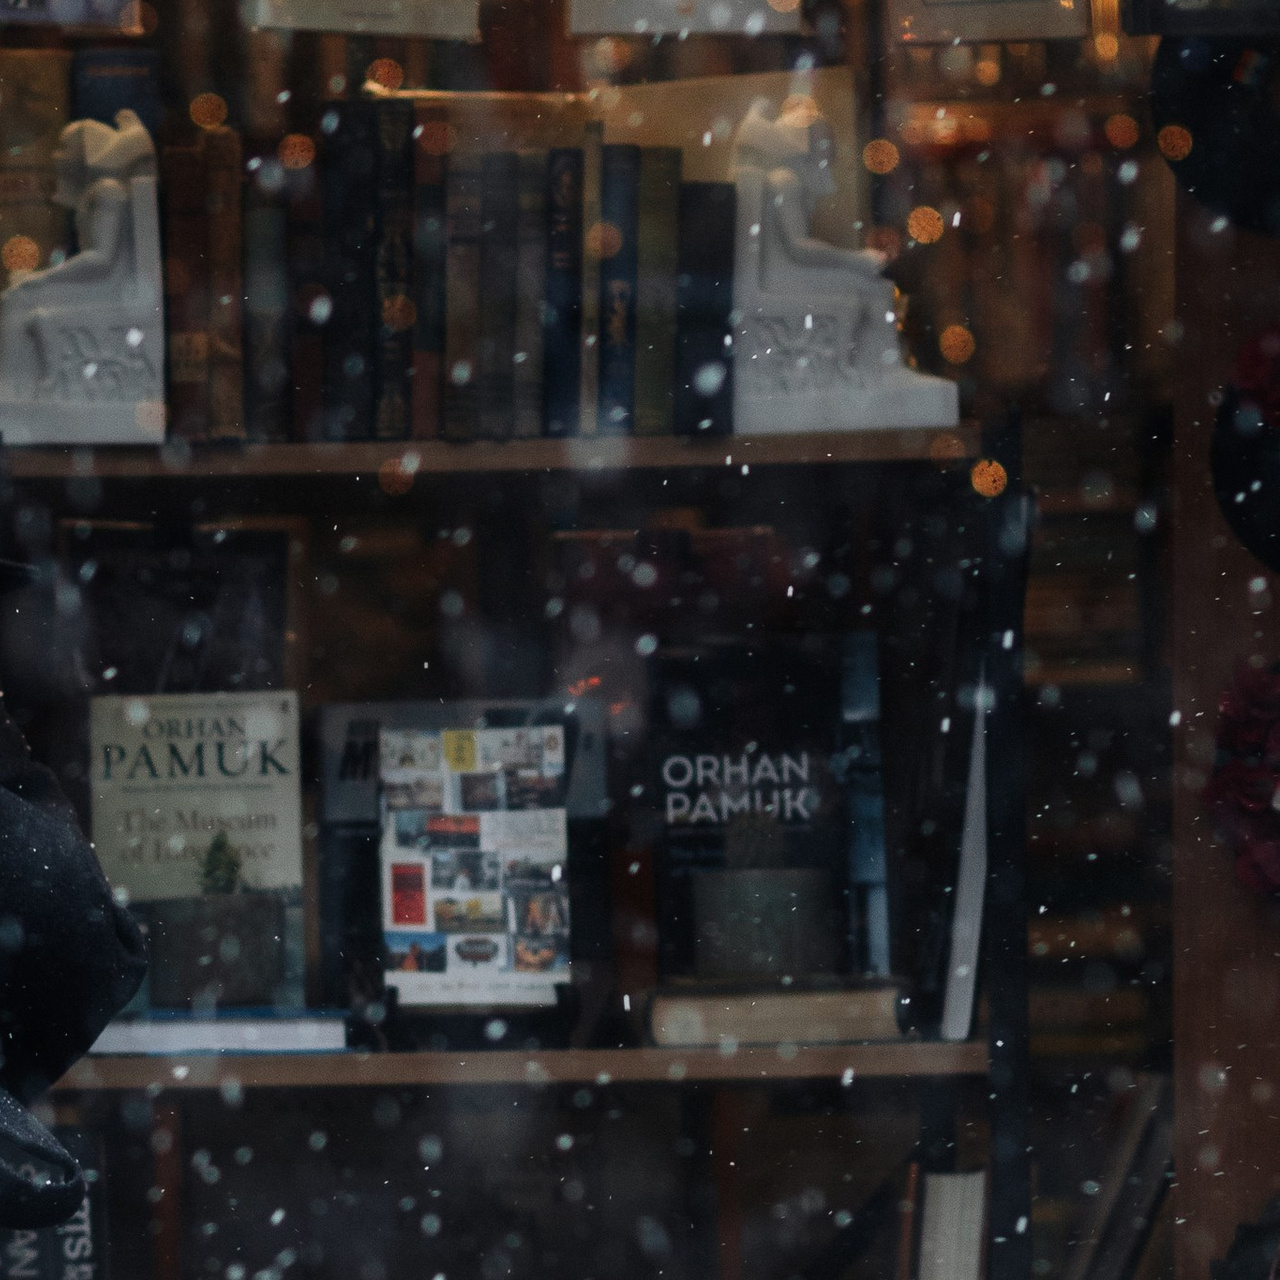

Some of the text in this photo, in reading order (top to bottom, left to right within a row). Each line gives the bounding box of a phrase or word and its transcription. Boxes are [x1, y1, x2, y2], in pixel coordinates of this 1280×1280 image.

[142, 717, 247, 739] ORHAN
[102, 739, 291, 780] PAMUK
[661, 750, 810, 788] ORHAN
[665, 786, 813, 824] PAMUK
